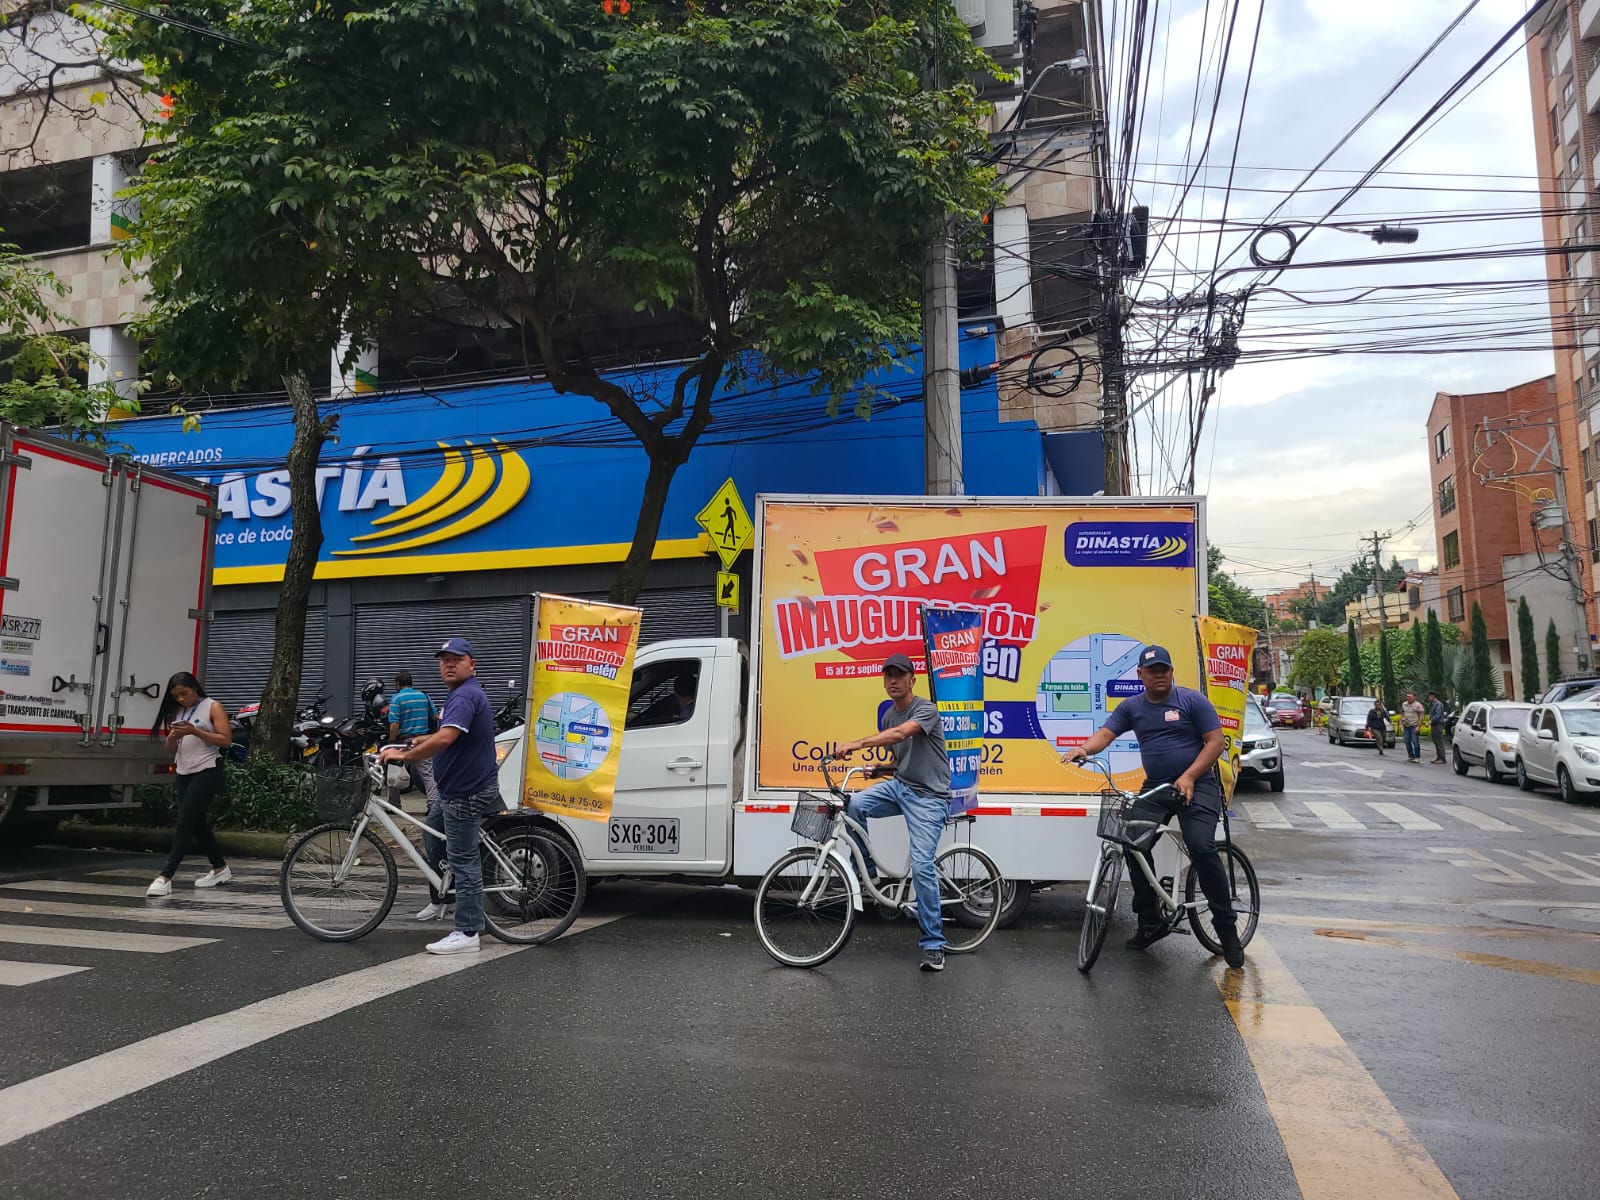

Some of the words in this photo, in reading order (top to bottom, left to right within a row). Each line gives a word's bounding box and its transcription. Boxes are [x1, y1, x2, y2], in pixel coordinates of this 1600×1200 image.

[197, 446, 407, 519] ASTÍA
[238, 528, 256, 543] de
[1076, 535, 1160, 548] DINASTÍA
[853, 537, 1006, 591] GRAN
[562, 627, 617, 642] GRAN
[941, 631, 975, 649] GRAN
[537, 641, 625, 666] INAUGURACIÓN
[1217, 646, 1245, 659] GRAN
[586, 664, 616, 679] Belén
[825, 667, 833, 676] 15
[836, 666, 843, 675] al
[845, 666, 856, 675] 22
[7, 705, 42, 717] TRANSPORTE
[43, 707, 49, 717] DE
[793, 763, 814, 772] Una
[528, 788, 548, 798] Calle
[551, 792, 566, 803] 30A
